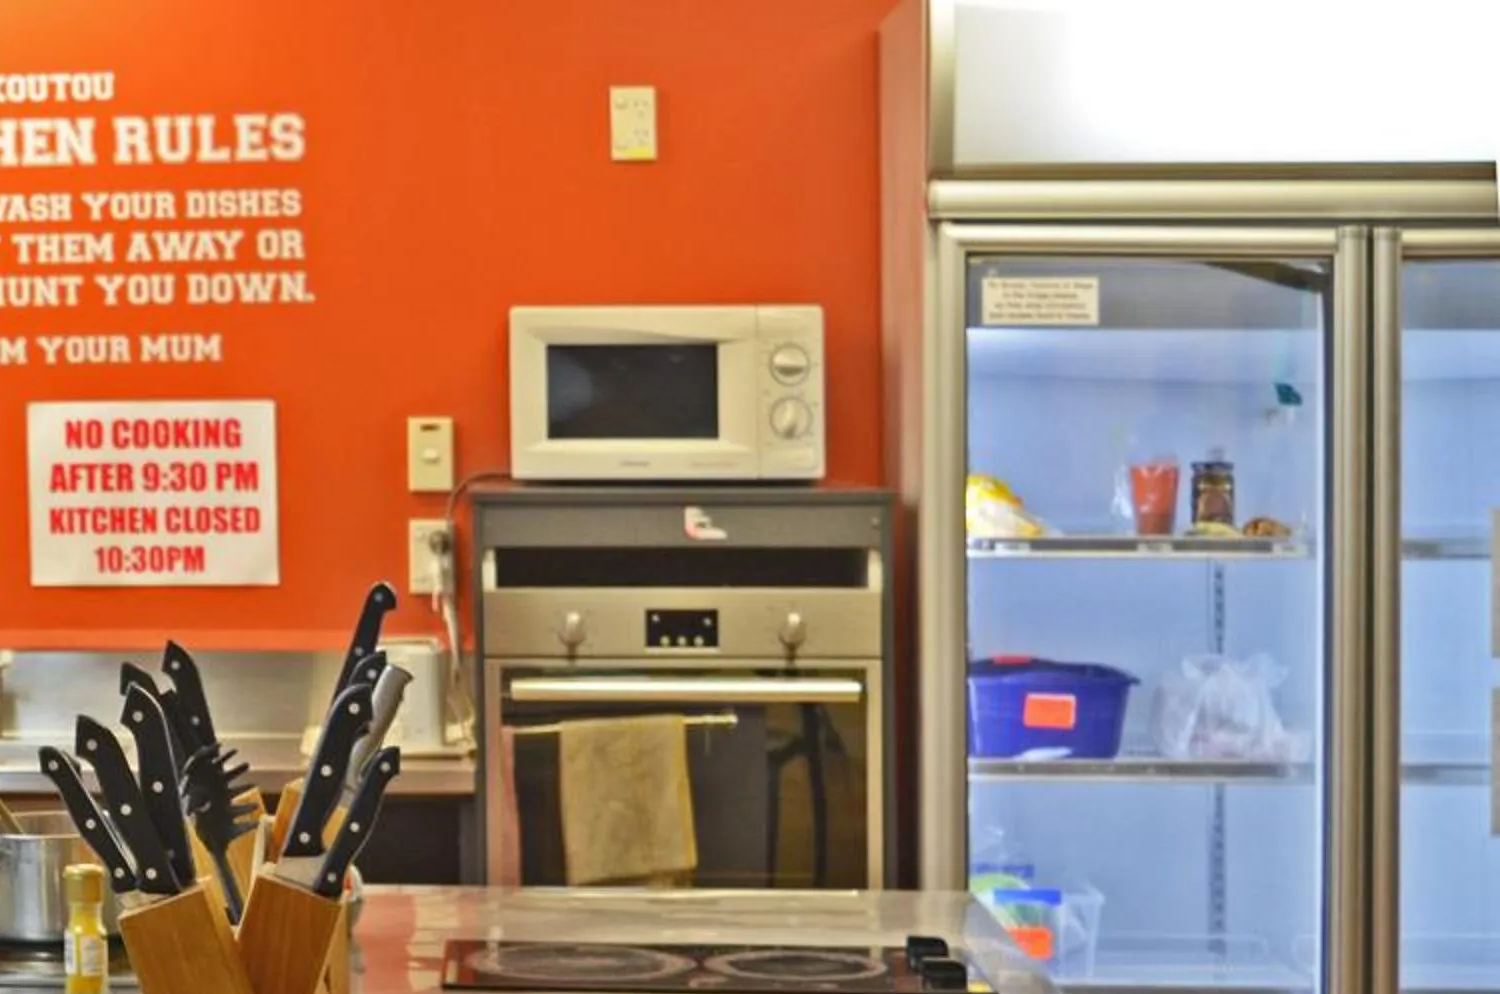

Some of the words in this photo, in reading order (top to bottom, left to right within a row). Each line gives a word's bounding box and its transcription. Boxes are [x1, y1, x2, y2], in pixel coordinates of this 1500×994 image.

[114, 114, 305, 164] RULES
[81, 192, 177, 219] YOUR
[187, 189, 302, 218] DISHES
[12, 233, 112, 263] THEM
[127, 231, 243, 261] AWAY
[257, 230, 304, 260] OR
[94, 274, 174, 304] YOU
[188, 272, 315, 303] DOWN.
[37, 336, 130, 364] YOUR
[141, 334, 222, 362] MUM
[66, 421, 102, 449] NO
[112, 418, 241, 448] COOKING
[50, 464, 133, 493] AFTER
[143, 463, 206, 491] 9:30
[215, 462, 258, 490] PM
[50, 508, 157, 535] KITCHEN
[165, 506, 260, 533] CLOSED
[95, 546, 204, 572] 10:30PM
